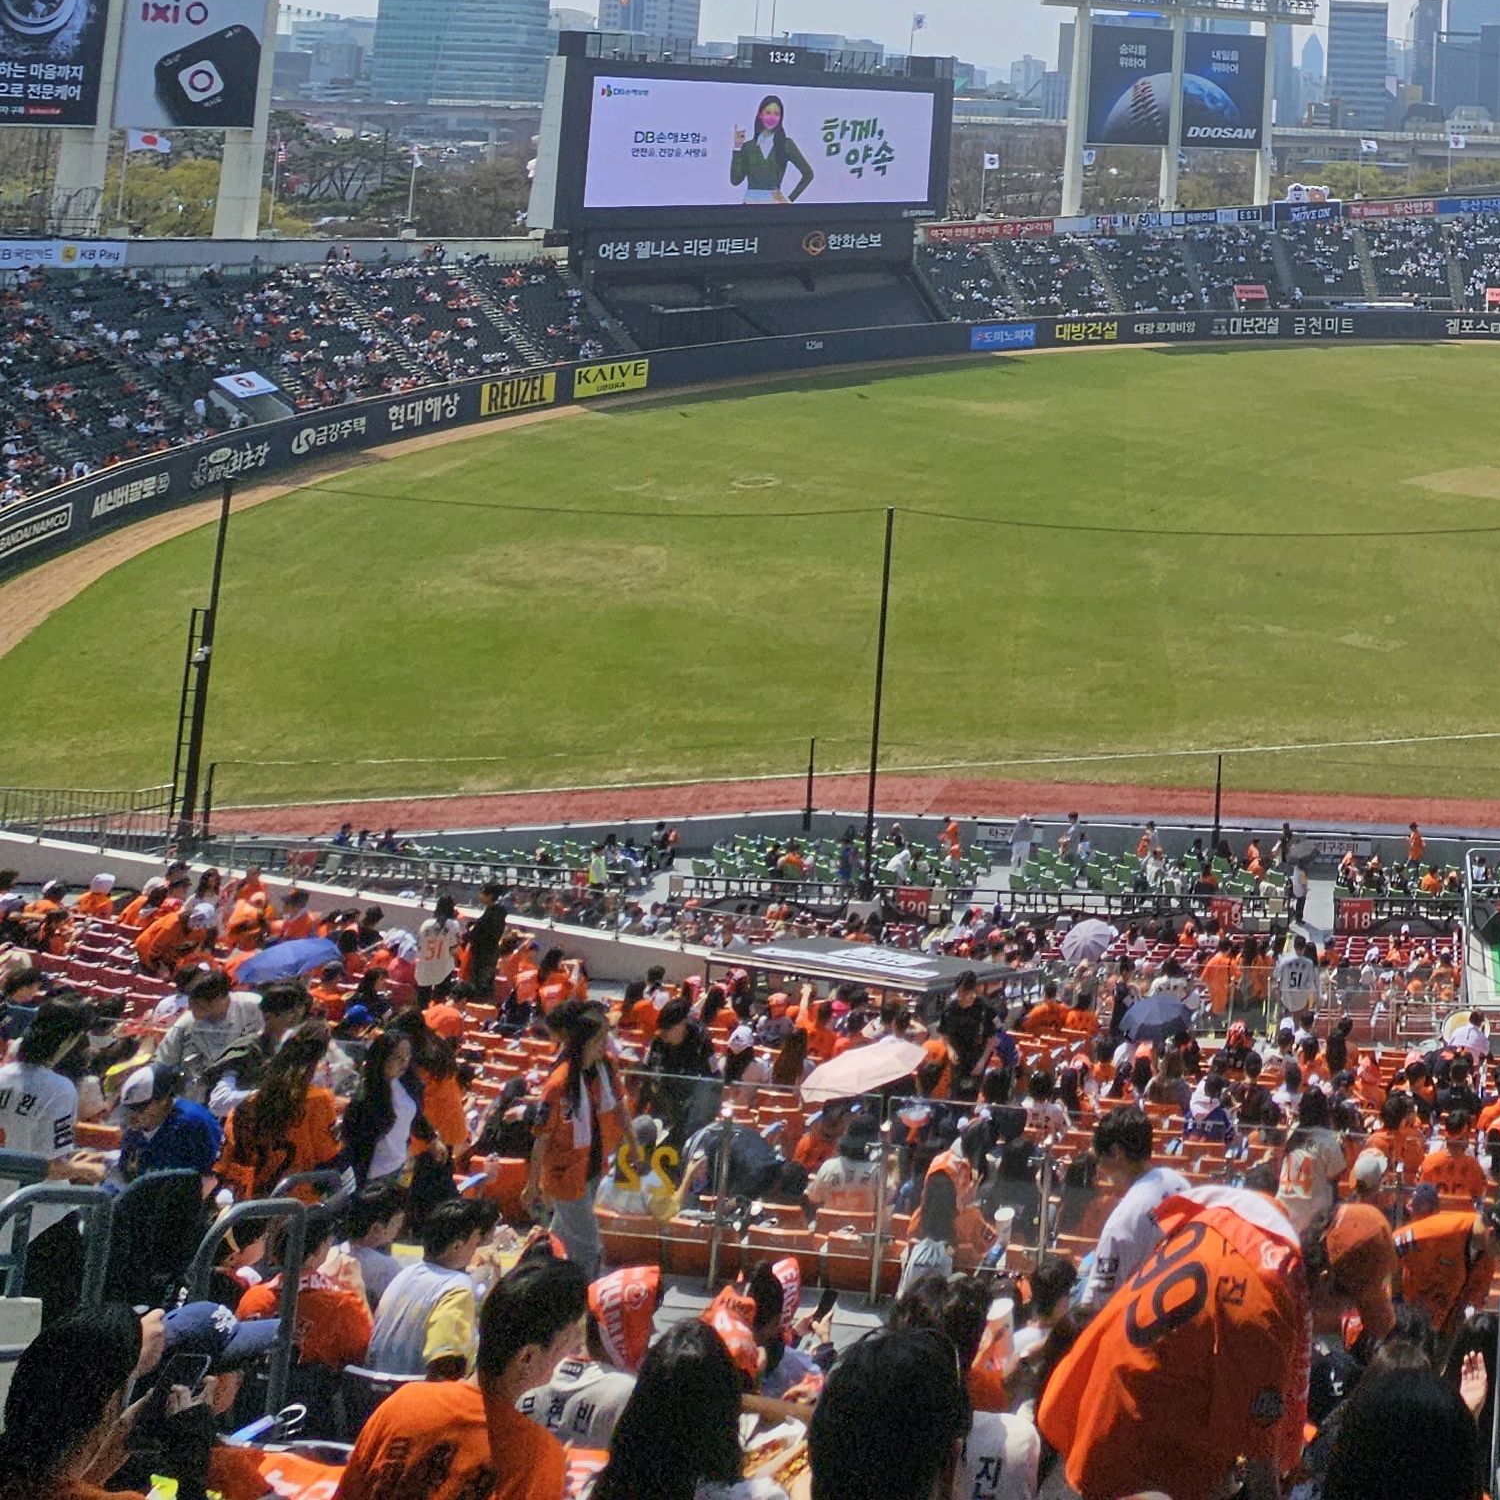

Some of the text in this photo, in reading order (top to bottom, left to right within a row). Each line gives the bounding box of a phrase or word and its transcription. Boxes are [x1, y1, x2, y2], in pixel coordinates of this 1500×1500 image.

[769, 51, 796, 64] 13:42
[1118, 43, 1147, 55] 승리를
[1211, 50, 1239, 62] 내일을
[29, 63, 84, 81] 마음까지
[1118, 57, 1147, 69] 위하여
[1211, 62, 1239, 74] 위하여
[26, 83, 82, 100] 전문케어
[821, 117, 884, 157] 함께,
[1186, 126, 1257, 140] DOOSAN
[844, 139, 895, 179] 약속
[1393, 200, 1435, 215] 두산밥캣
[598, 236, 759, 260] 여성 웰니스 리딩 파트너
[827, 233, 882, 250] 한화손보
[80, 249, 120, 263] KB Pay
[1054, 321, 1118, 342] 대방건설
[1229, 317, 1280, 335] 대보건설
[1293, 316, 1355, 336] 금천미트
[805, 340, 824, 350] 125m
[984, 330, 1035, 343] 도미노피자
[576, 361, 646, 387] KAIVE
[487, 373, 547, 413] REUZEL
[388, 392, 460, 432] 현대해상
[315, 415, 367, 447] 금강주택
[31, 511, 68, 536] NAMCO
[899, 900, 928, 918] 120
[1342, 911, 1372, 929] 118
[1290, 971, 1303, 988] 51
